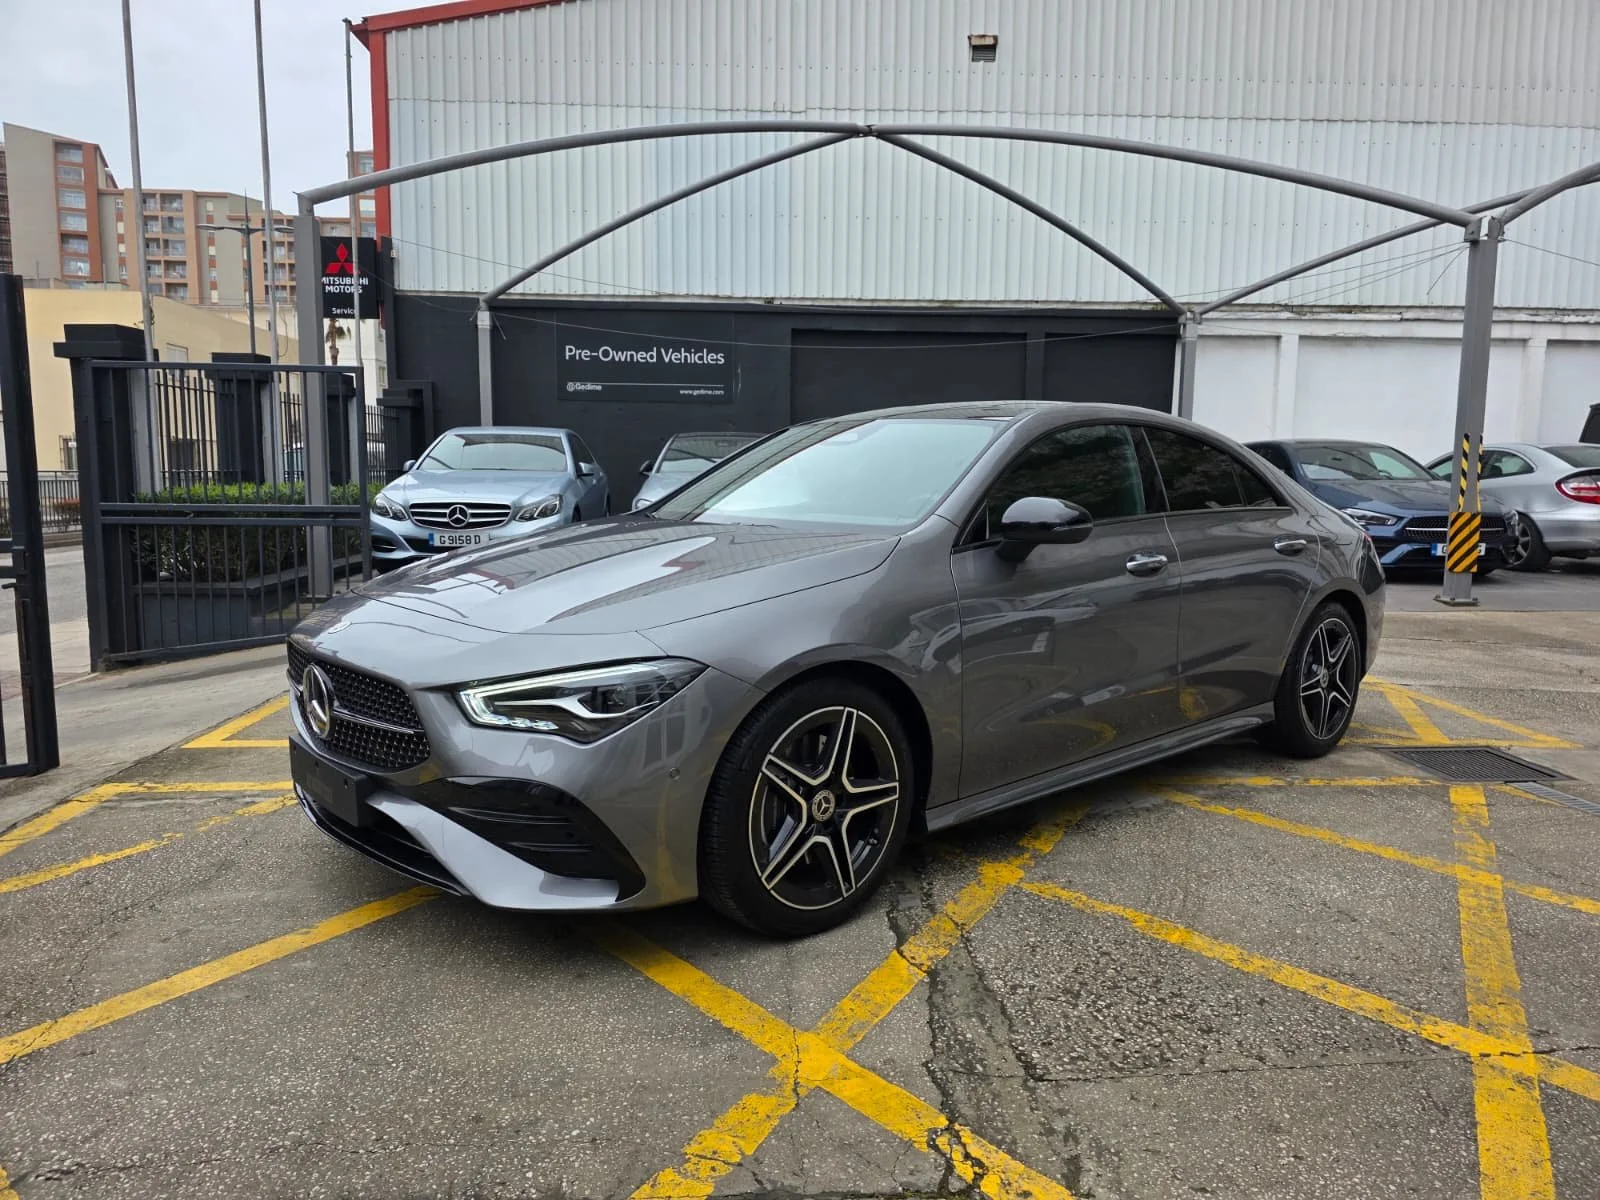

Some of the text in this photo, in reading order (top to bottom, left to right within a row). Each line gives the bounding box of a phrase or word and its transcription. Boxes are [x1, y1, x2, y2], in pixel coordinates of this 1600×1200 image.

[321, 276, 369, 285] MITSUBIHI
[564, 345, 725, 364] Pre-Owned Vehicles
[439, 534, 481, 545] G 9158 D
